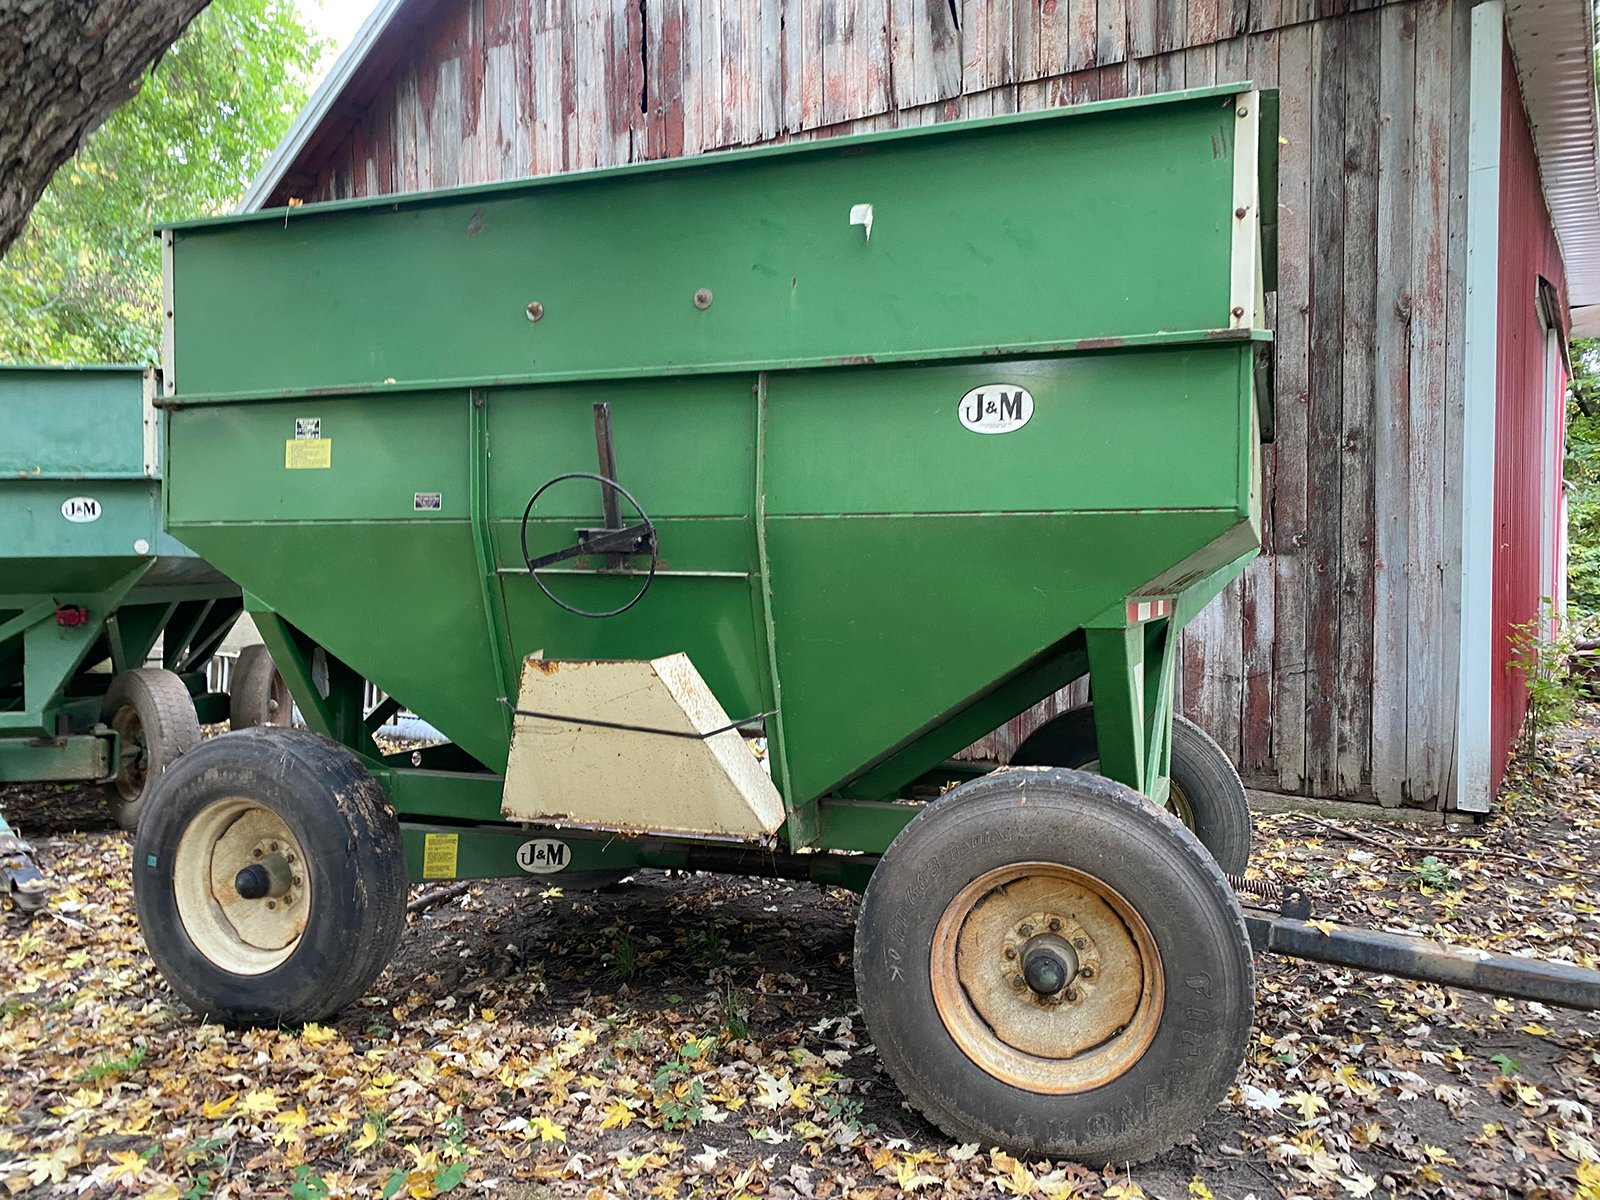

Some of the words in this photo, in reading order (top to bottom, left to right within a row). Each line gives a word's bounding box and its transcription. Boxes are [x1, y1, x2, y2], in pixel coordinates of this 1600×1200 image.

[965, 390, 1024, 422] J&M
[65, 502, 96, 517] J&M
[520, 843, 565, 865] J&M
